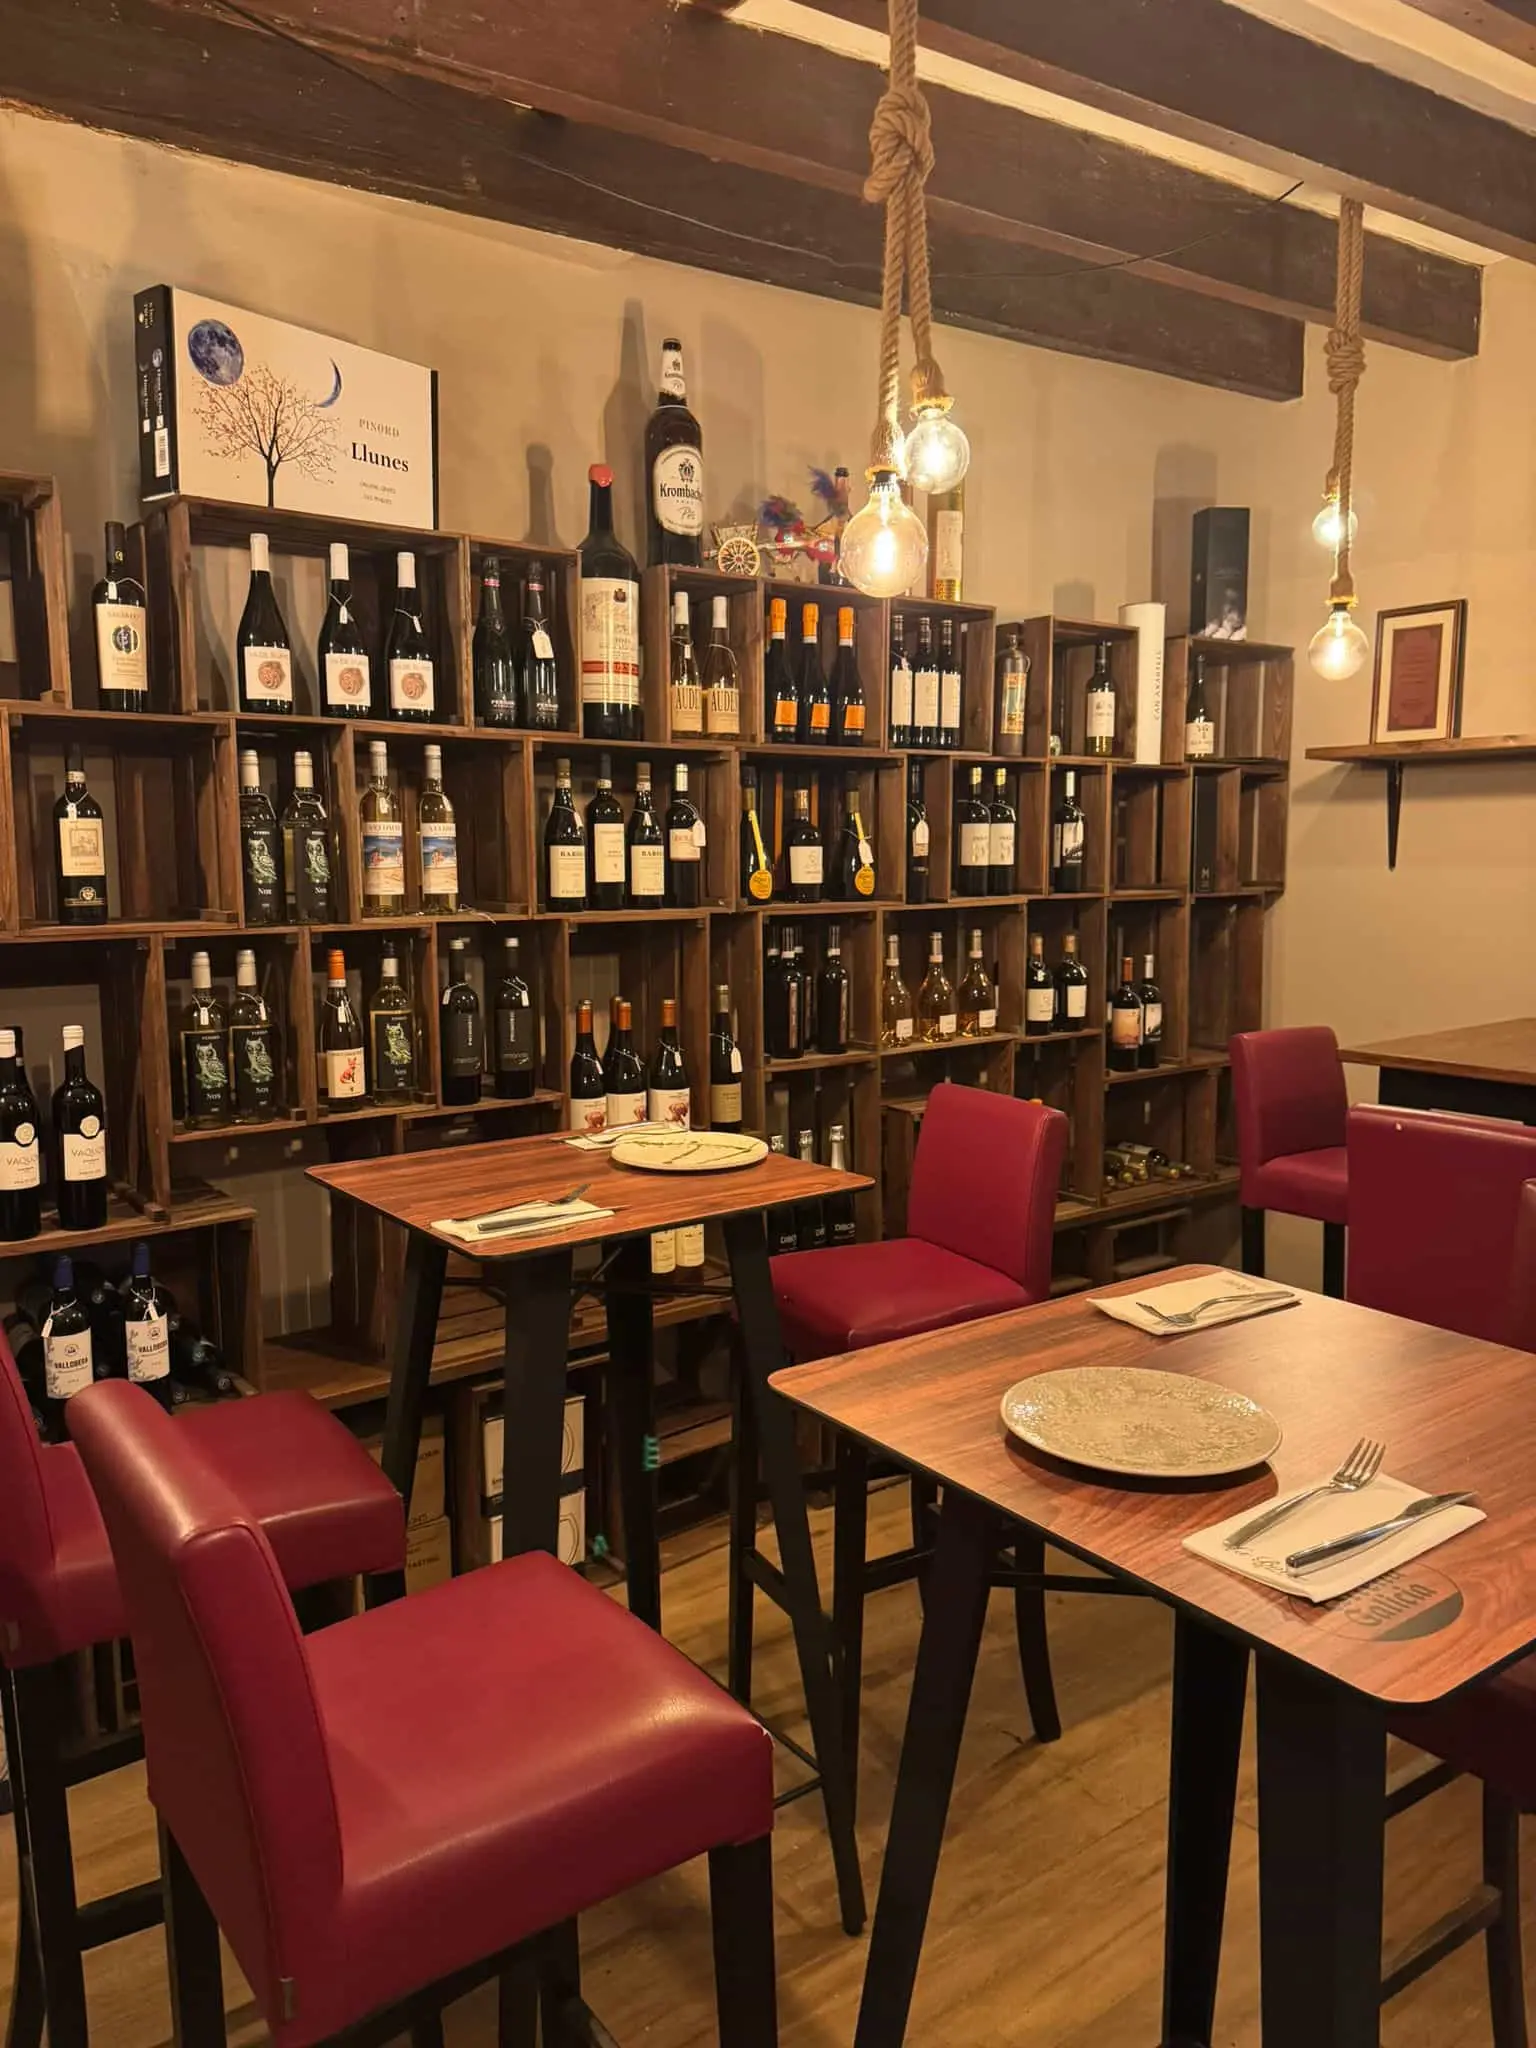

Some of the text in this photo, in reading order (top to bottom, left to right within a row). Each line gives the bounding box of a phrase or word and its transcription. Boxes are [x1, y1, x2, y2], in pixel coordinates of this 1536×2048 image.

[359, 418, 400, 438] PINORD
[351, 441, 409, 473] Llunes
[1344, 1583, 1438, 1627] Galicia
